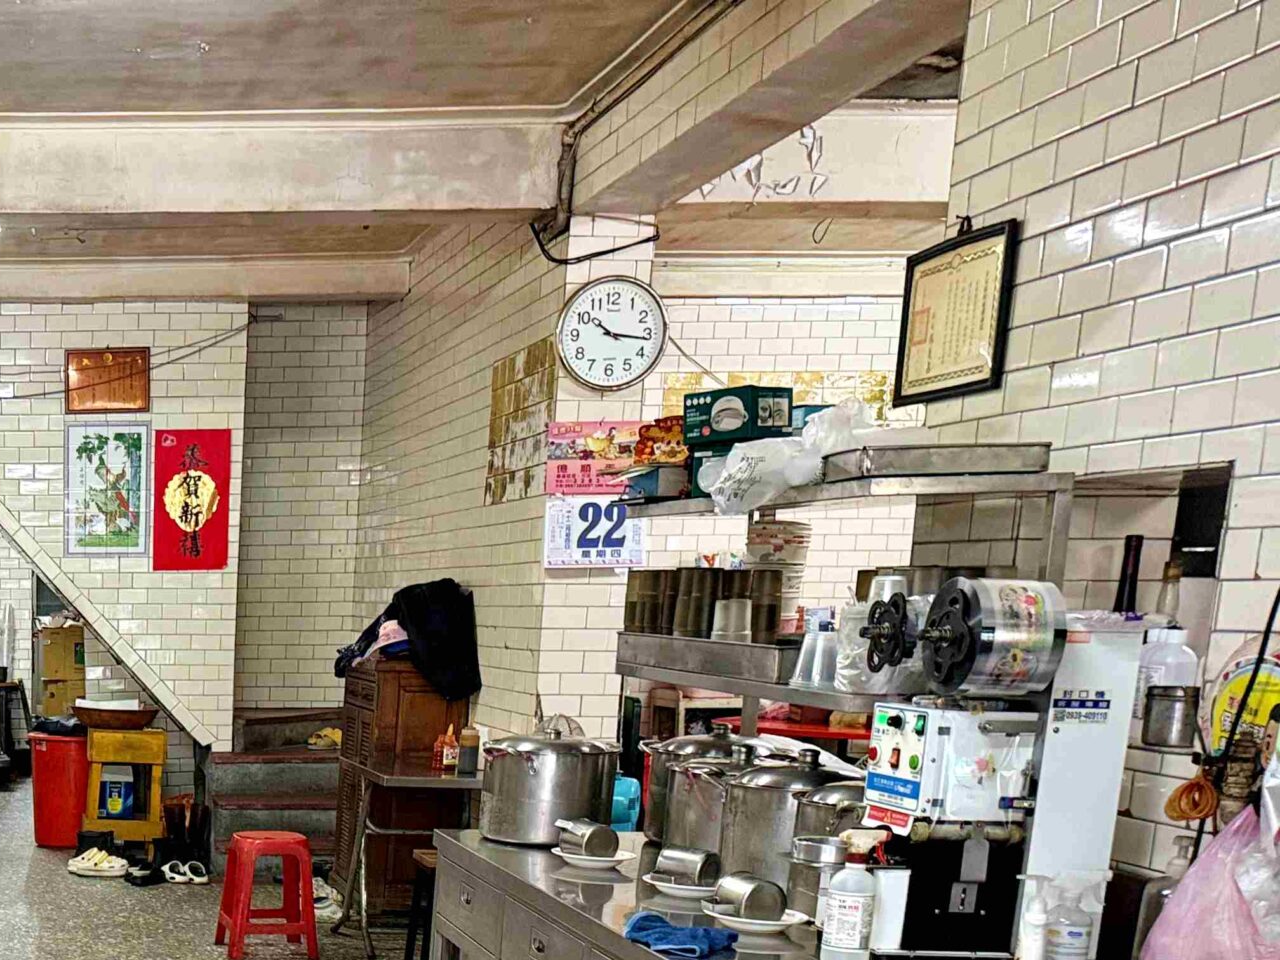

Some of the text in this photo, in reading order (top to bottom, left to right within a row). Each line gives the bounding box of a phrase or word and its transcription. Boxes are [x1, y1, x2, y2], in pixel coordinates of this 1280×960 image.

[591, 298, 602, 311] 11
[606, 292, 621, 306] 12
[631, 297, 635, 310] 1
[577, 311, 591, 325] 10
[639, 310, 648, 323] 2
[570, 328, 580, 342] 9
[643, 327, 652, 341] 3
[575, 346, 585, 360] 8
[635, 346, 645, 359] 4
[587, 359, 597, 372] 7
[604, 363, 614, 377] 6
[623, 358, 632, 372] 5
[177, 442, 209, 559] 恭賀新禧
[576, 502, 628, 548] 22
[581, 550, 621, 558] 星期四
